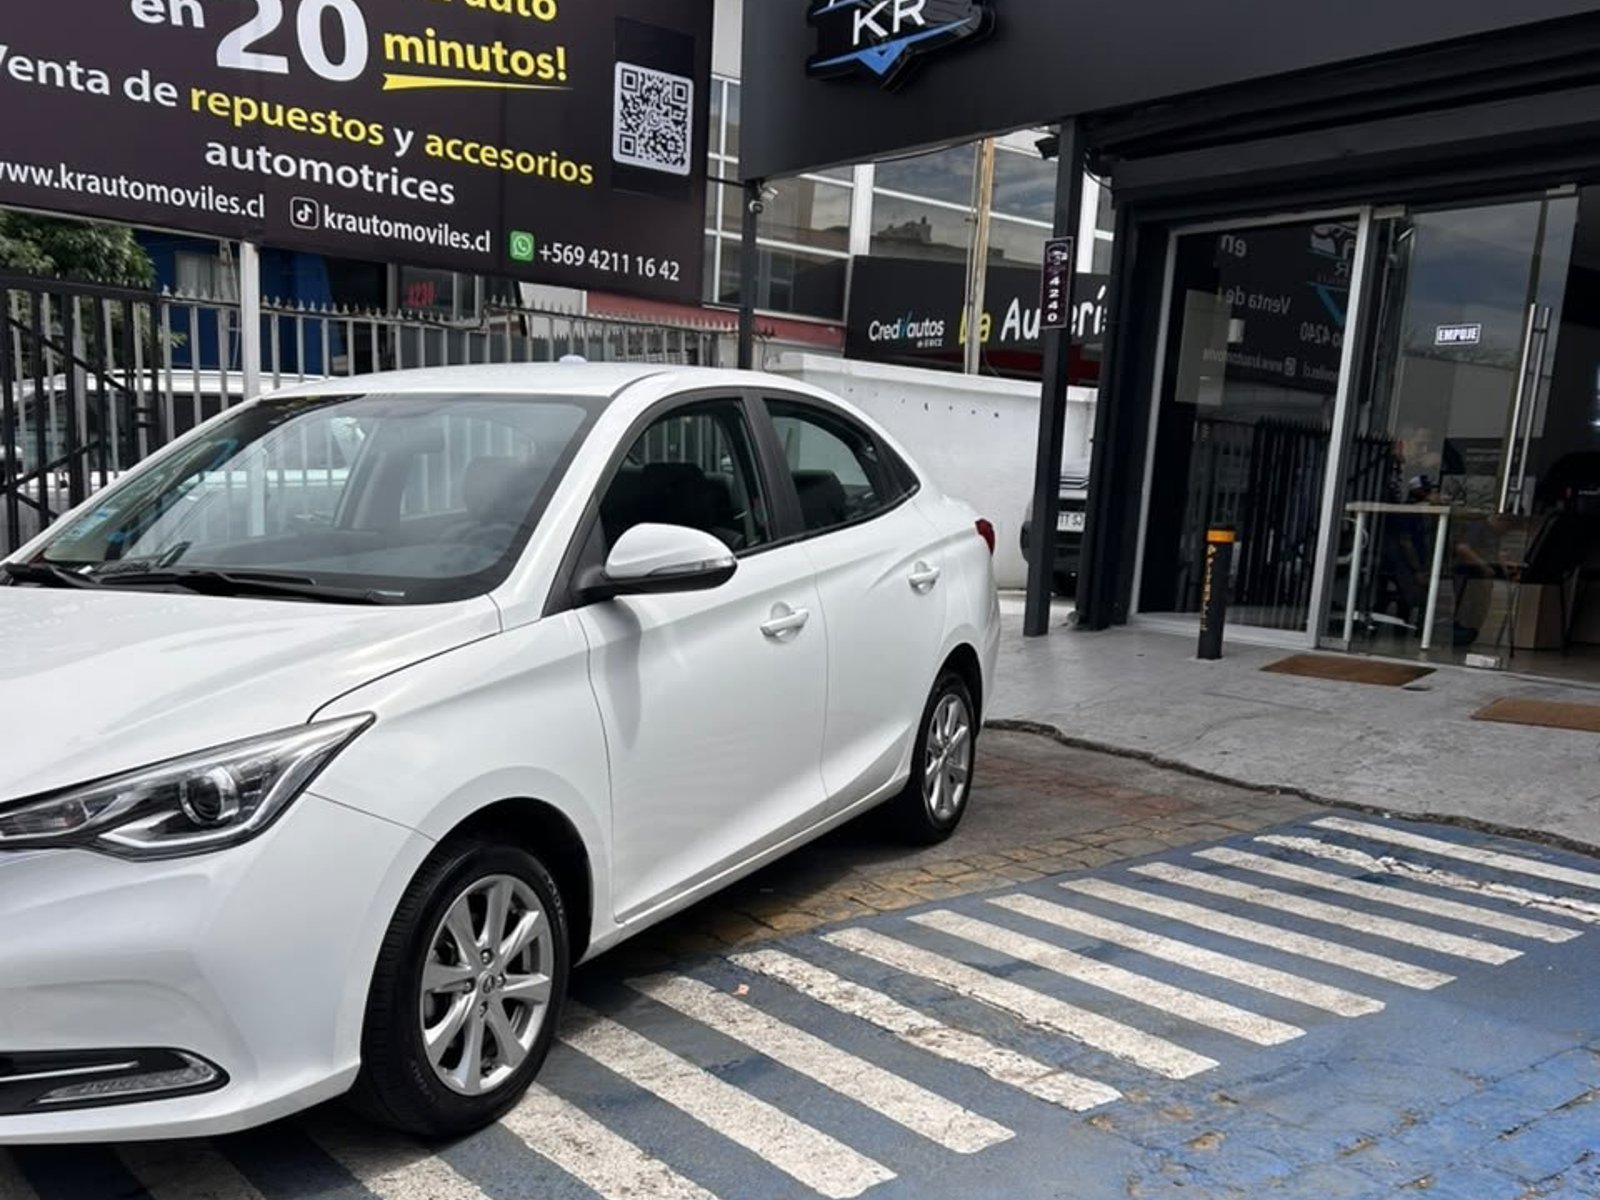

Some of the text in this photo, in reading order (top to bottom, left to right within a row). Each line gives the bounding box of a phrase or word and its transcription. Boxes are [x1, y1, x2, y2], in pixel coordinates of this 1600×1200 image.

[131, 0, 369, 82] en 20
[384, 27, 567, 81] minutos!
[123, 69, 178, 107] de
[190, 87, 385, 146] repuestos
[393, 127, 414, 157] y
[425, 133, 594, 185] accesorios
[0, 161, 265, 219] ww.krautomoviles.cl
[205, 141, 455, 205] automotrices
[323, 204, 491, 252] krautomoviles.cl
[539, 243, 680, 282] +569 4211 16 42
[1047, 276, 1060, 322] 4240
